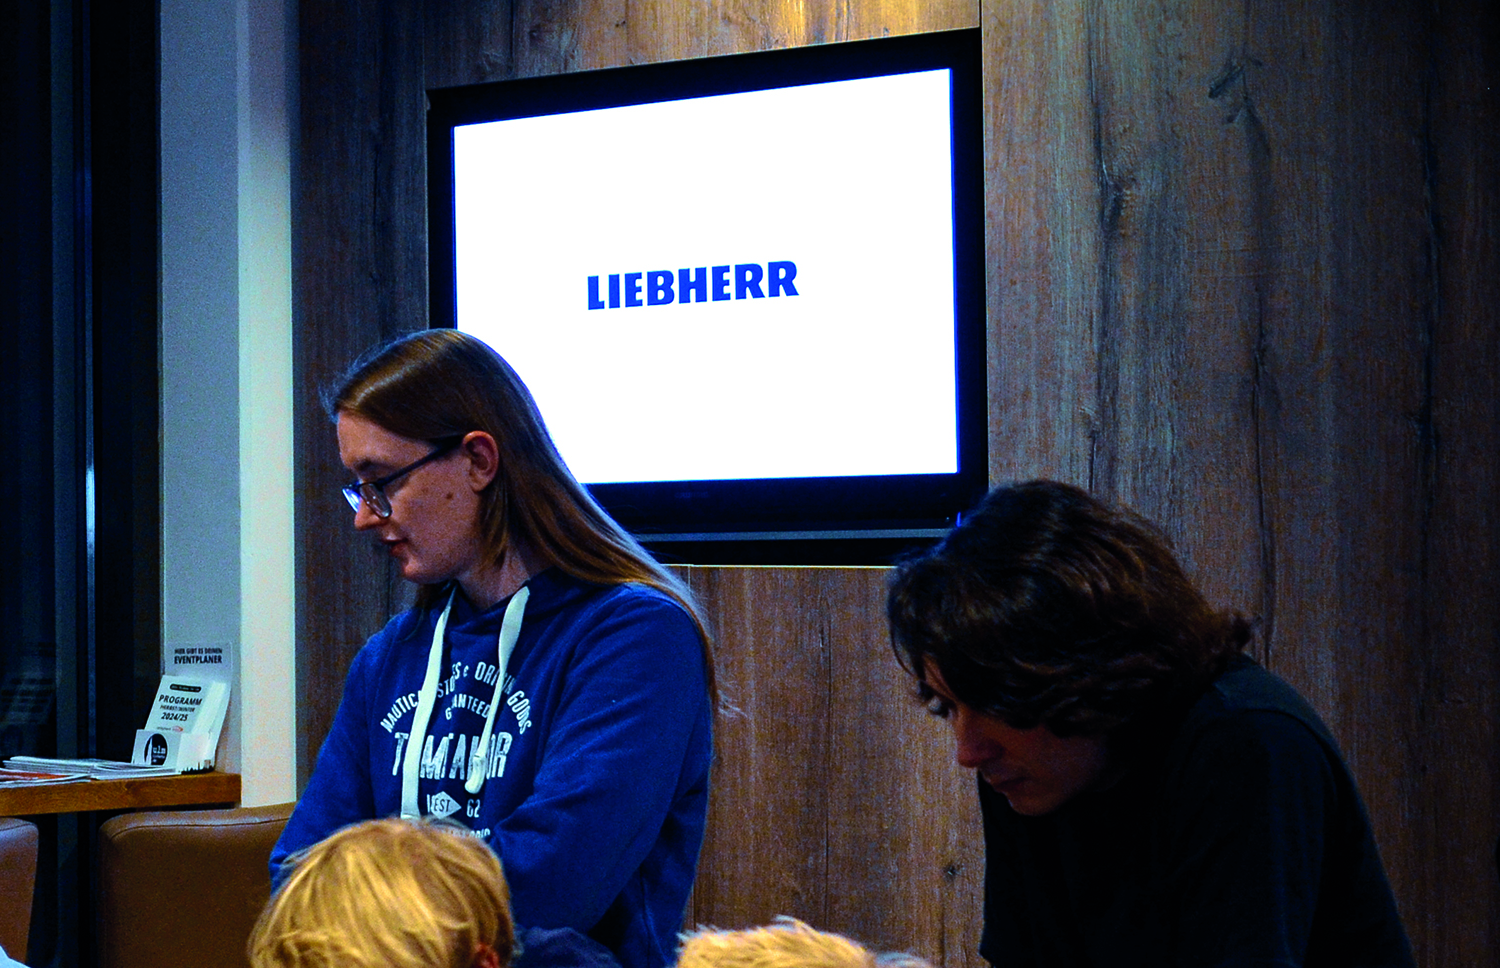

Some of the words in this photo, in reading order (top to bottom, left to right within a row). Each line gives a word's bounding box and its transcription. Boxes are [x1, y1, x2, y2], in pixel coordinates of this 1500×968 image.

[587, 260, 800, 310] LIEBHERR
[174, 655, 223, 664] EVENTPLANER
[159, 694, 202, 706] PROGRAMM
[445, 693, 491, 720] GANTEED
[161, 711, 189, 721] 2024/25
[380, 688, 421, 734] NAUTIC
